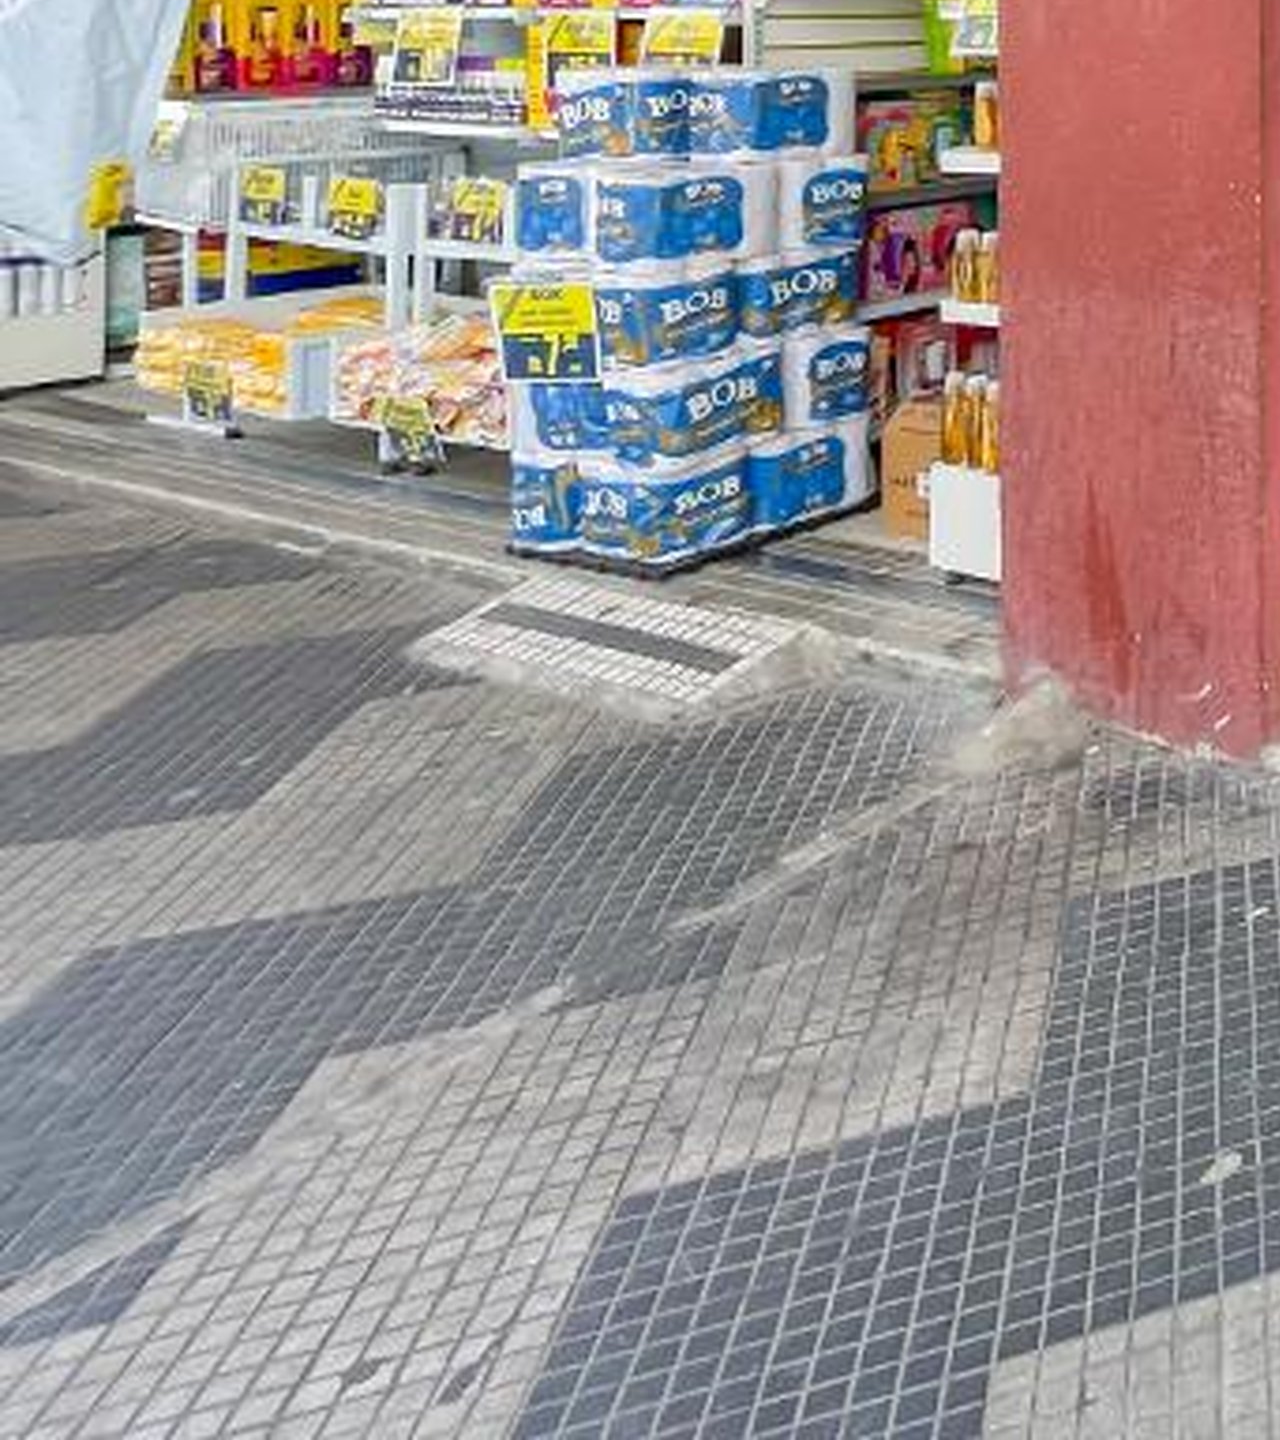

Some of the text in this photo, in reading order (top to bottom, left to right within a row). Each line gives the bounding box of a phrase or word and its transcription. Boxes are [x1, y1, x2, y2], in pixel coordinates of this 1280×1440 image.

[558, 98, 611, 129] BOB
[811, 179, 864, 204] BOB
[659, 287, 729, 323] BOB
[769, 269, 838, 305] BOB
[686, 376, 758, 421] BOB
